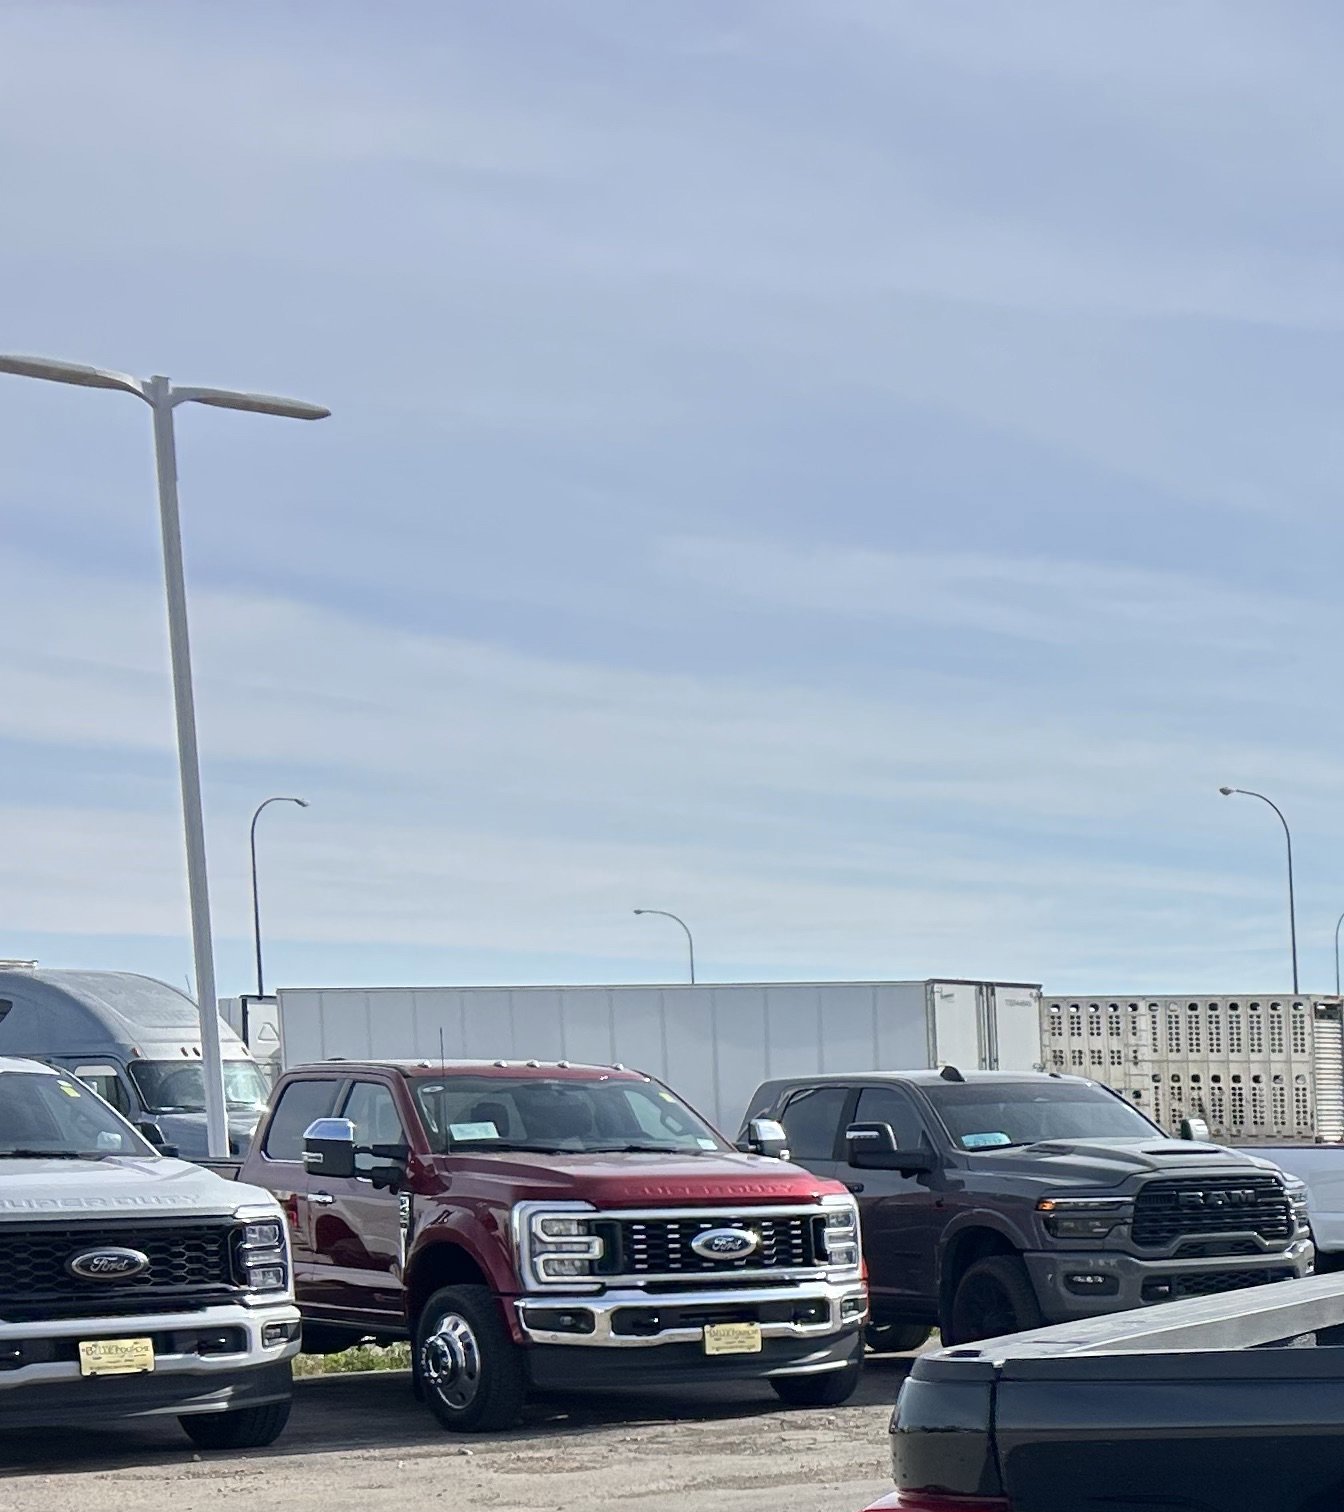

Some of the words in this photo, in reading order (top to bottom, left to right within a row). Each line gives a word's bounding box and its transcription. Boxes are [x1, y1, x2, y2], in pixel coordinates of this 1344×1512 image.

[0, 1197, 107, 1209] UPER
[1178, 1190, 1255, 1206] RAM
[712, 1236, 742, 1251] Ford
[90, 1256, 129, 1272] Ford
